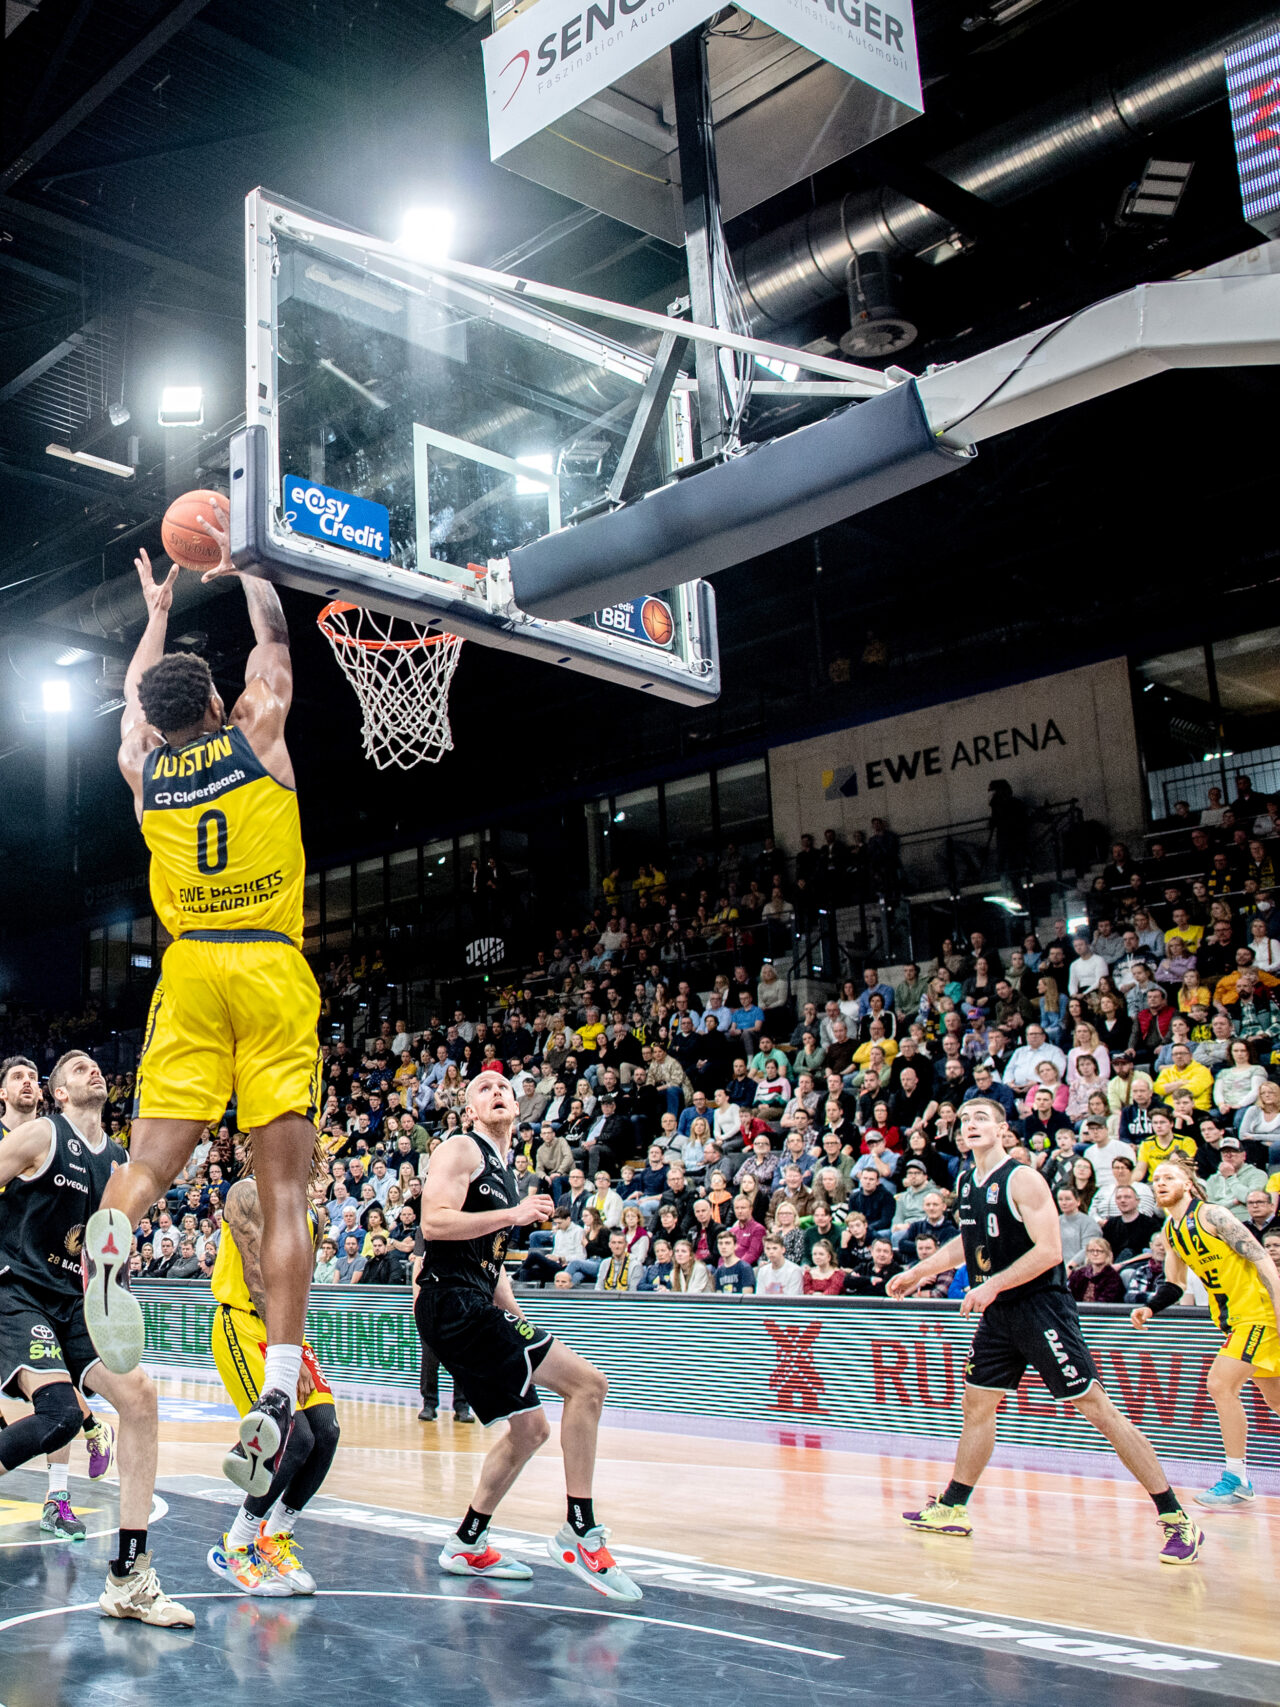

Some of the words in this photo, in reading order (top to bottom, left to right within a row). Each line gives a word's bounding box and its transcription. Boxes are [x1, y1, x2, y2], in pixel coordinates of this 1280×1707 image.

[538, 30, 624, 94] Faszination
[848, 29, 909, 71] Automobil
[319, 513, 384, 552] Credit
[601, 607, 636, 633] BBL
[865, 745, 943, 790] EWE
[950, 718, 1067, 770] ARENA
[197, 808, 228, 876] 0
[179, 886, 206, 903] EWE
[210, 870, 283, 898] BASKETS
[465, 937, 505, 967] JEVER
[987, 1212, 1000, 1237] 9
[1192, 1234, 1204, 1253] 2
[47, 1253, 60, 1265] 28
[29, 1344, 62, 1361] S+K
[128, 1538, 137, 1560] CRAFT
